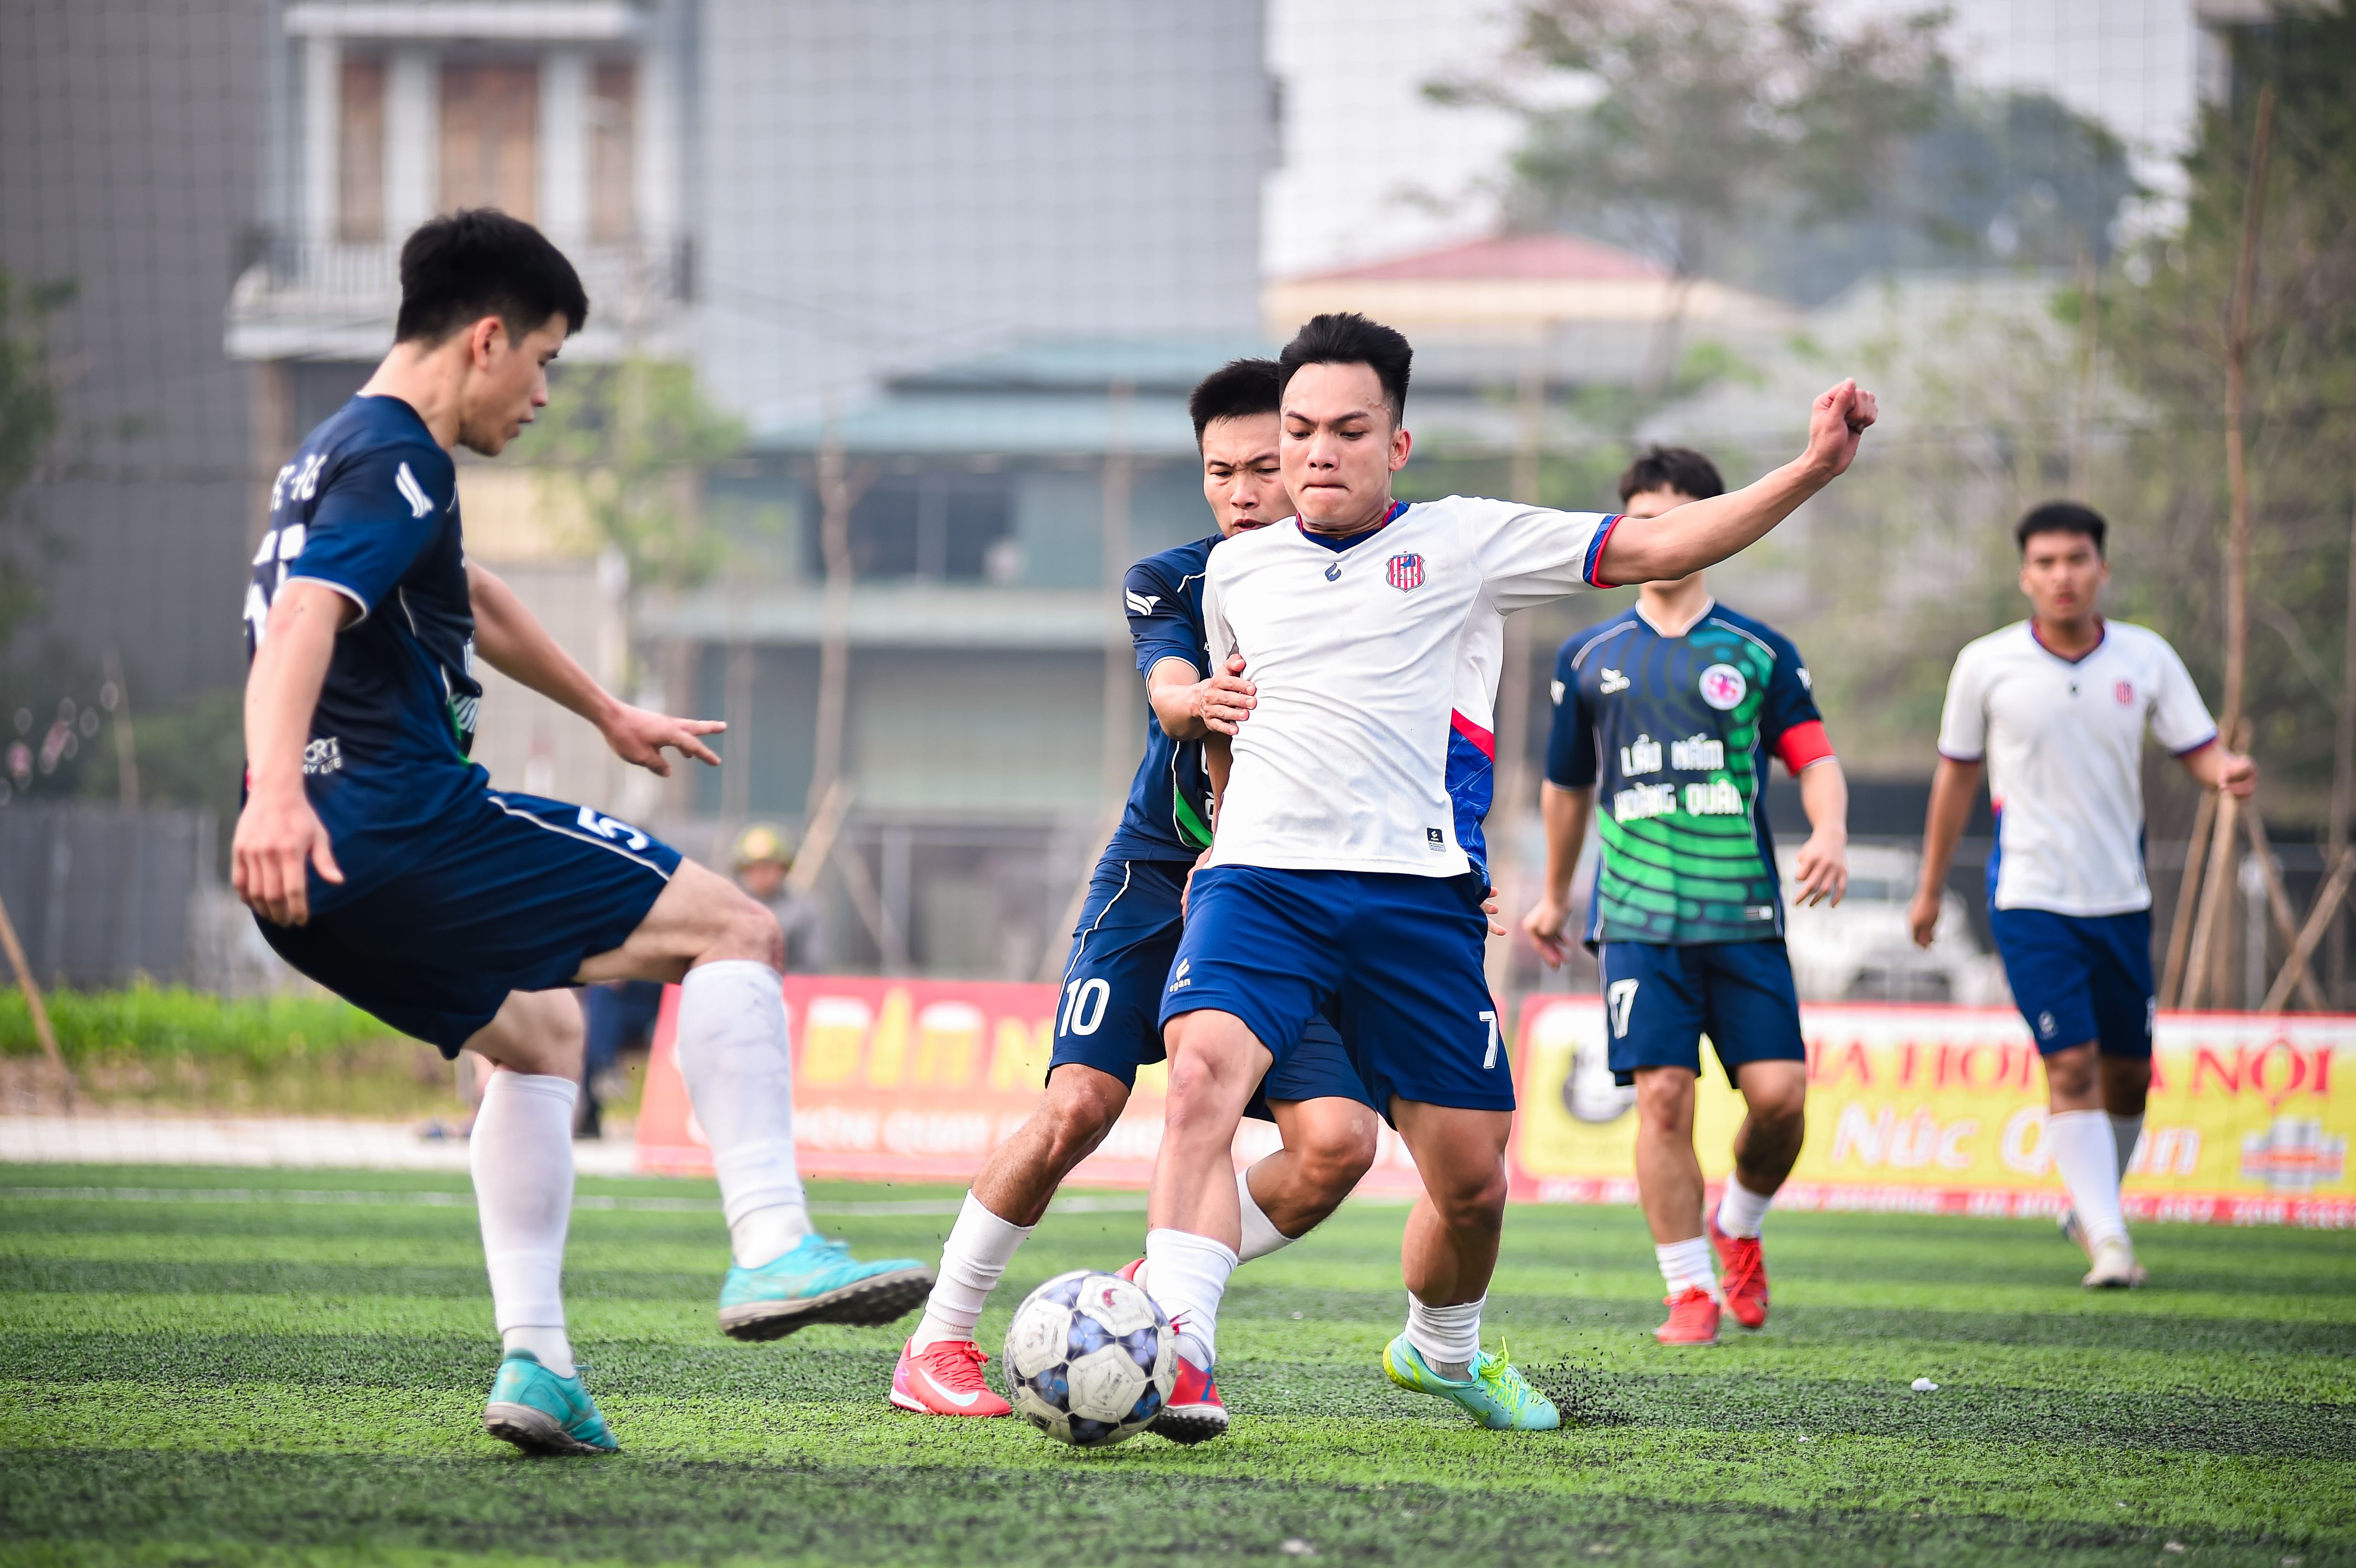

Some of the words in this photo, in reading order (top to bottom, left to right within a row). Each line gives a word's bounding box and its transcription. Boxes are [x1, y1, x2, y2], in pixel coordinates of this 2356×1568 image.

[577, 806, 649, 850] 5
[1059, 978, 1110, 1037] 10
[1169, 978, 1190, 992] egan
[1479, 1011, 1498, 1069] 7
